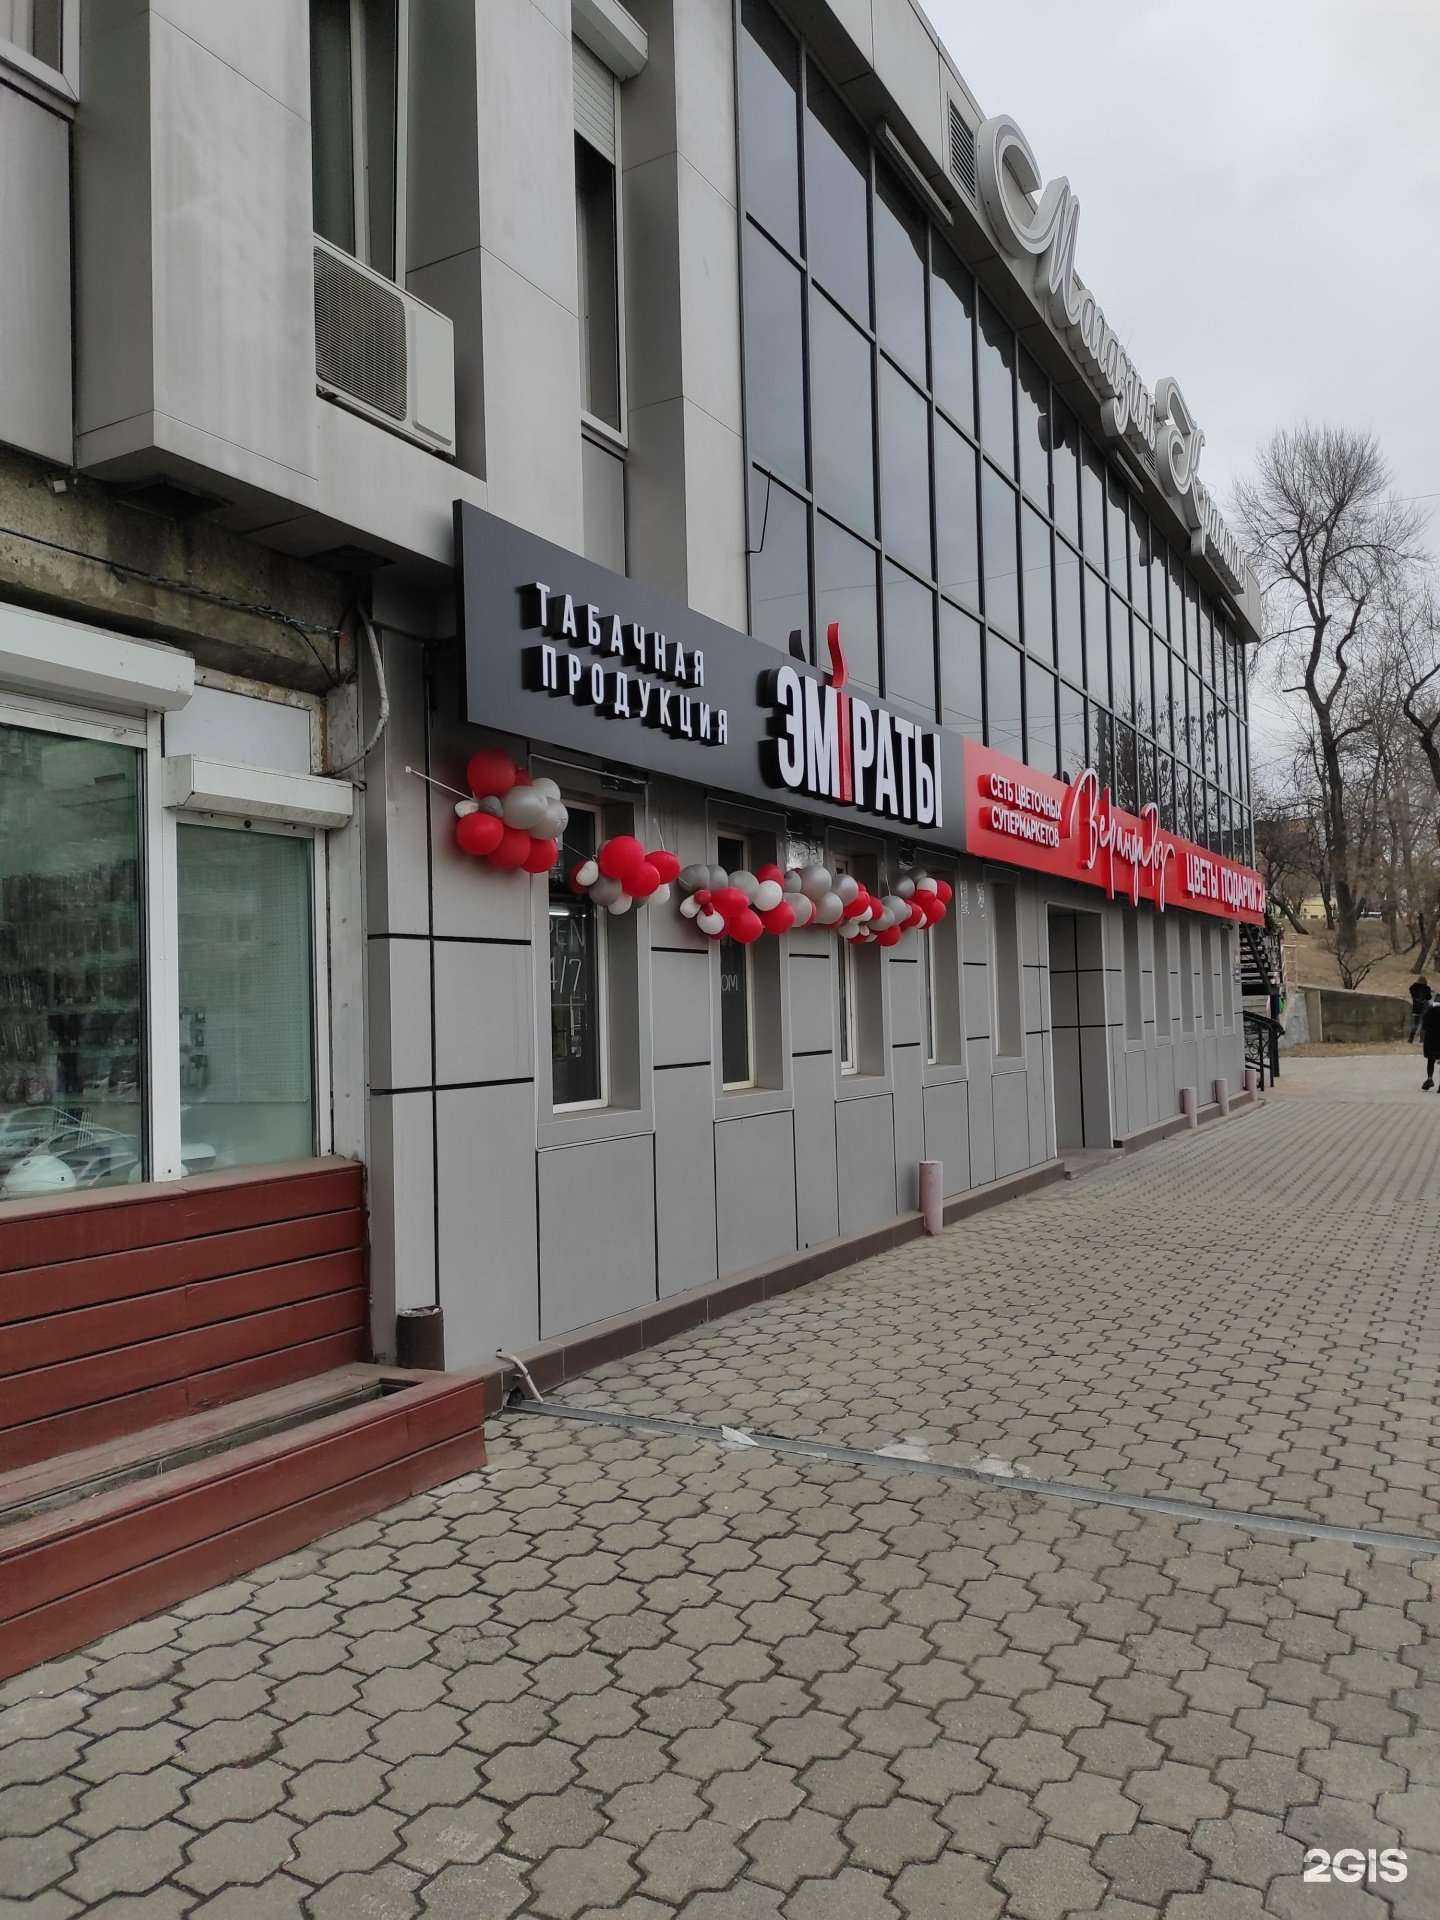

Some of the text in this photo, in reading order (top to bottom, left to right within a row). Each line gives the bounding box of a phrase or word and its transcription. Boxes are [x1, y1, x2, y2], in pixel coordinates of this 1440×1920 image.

[535, 581, 705, 687] ТАБАЧНАЯ
[541, 645, 729, 746] ПРОДУКЦИЯ
[990, 772, 1062, 820] СЕТЬ ЦВЕТОЧНЫХ
[991, 806, 1061, 849] СУПЕРМАРКЕТОВ
[1186, 852, 1219, 900] ЦВЕТЫ
[1220, 865, 1257, 913] ПОДАРКИ
